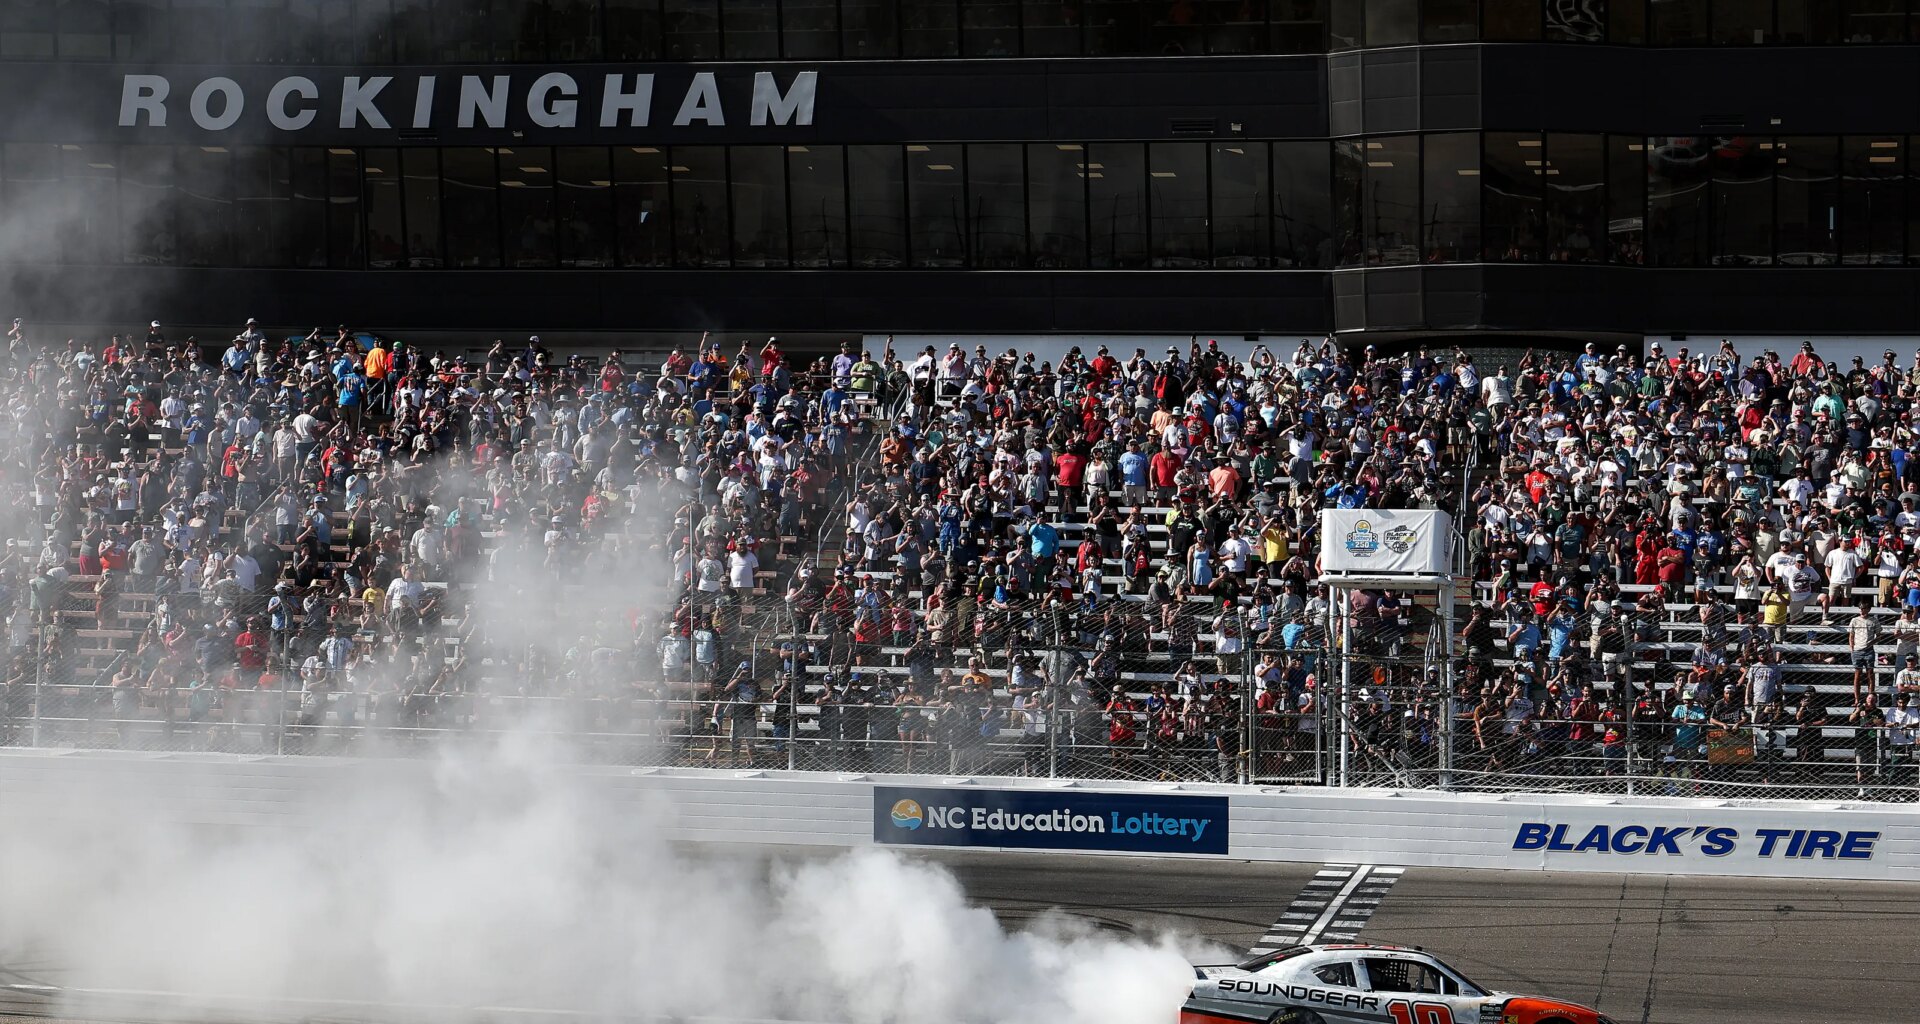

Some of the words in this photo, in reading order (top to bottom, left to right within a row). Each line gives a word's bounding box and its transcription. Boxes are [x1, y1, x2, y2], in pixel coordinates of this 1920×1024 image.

[119, 70, 818, 131] ROCKINGHAM
[927, 805, 966, 830] NC
[971, 807, 1105, 834] Education
[1111, 811, 1208, 843] Lottery
[1511, 822, 1740, 857] BLACK'S
[1754, 828, 1882, 861] TIRE
[1218, 979, 1379, 1012] SOUNDGEAR
[1275, 1012, 1297, 1024] EAGLE
